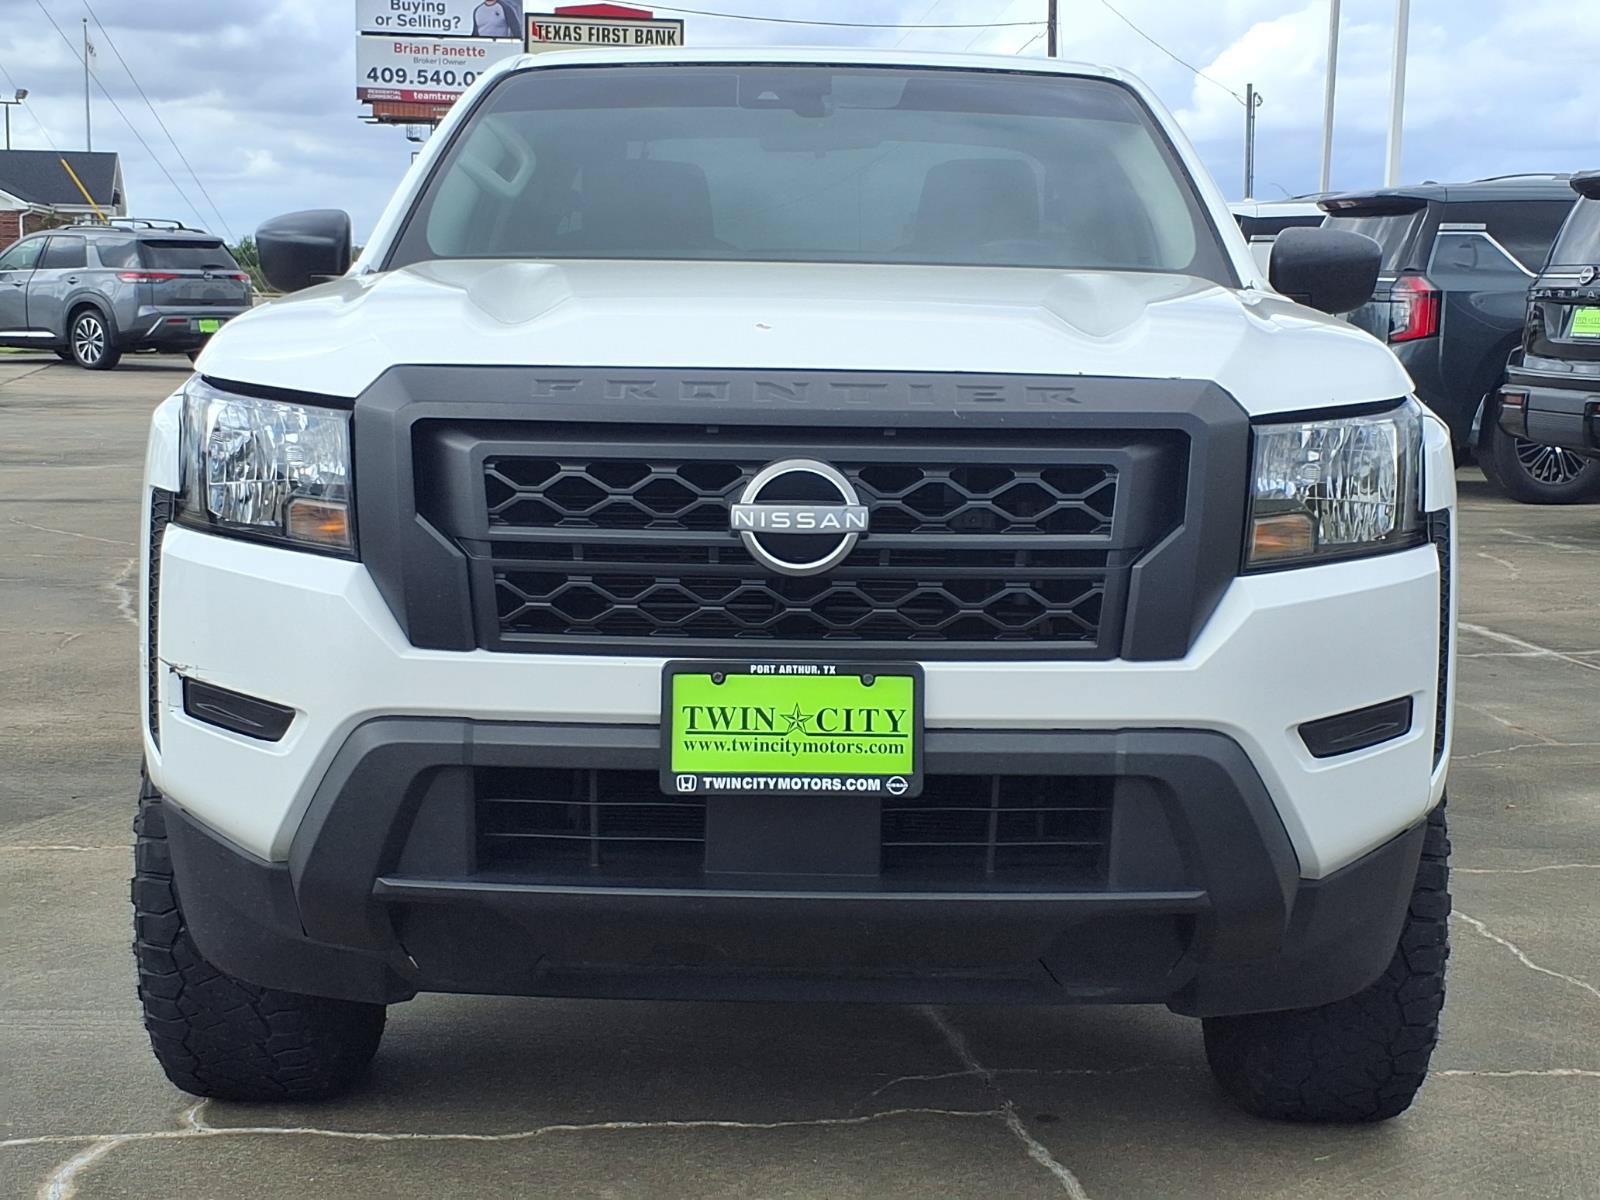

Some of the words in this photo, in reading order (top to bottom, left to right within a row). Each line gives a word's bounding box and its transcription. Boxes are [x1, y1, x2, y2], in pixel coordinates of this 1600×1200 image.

[390, 0, 446, 15] Buying
[375, 15, 392, 26] or
[397, 14, 461, 31] Selling?
[536, 24, 582, 42] TEXAS
[588, 26, 630, 44] FIRST
[634, 28, 677, 46] BANK
[394, 42, 429, 55] Brian
[433, 44, 486, 57] Fanette
[413, 57, 437, 65] Broker
[442, 58, 466, 66] Owner
[532, 378, 1083, 405] FRONTIER
[734, 510, 866, 529] NISSAN
[750, 664, 776, 674] PORT
[823, 665, 836, 675] TX
[682, 705, 776, 731] TWIN
[815, 707, 909, 733] CITY
[683, 736, 905, 757] www.twincitymotors.com
[702, 776, 881, 791] TWINCITYMOTORS.COM
